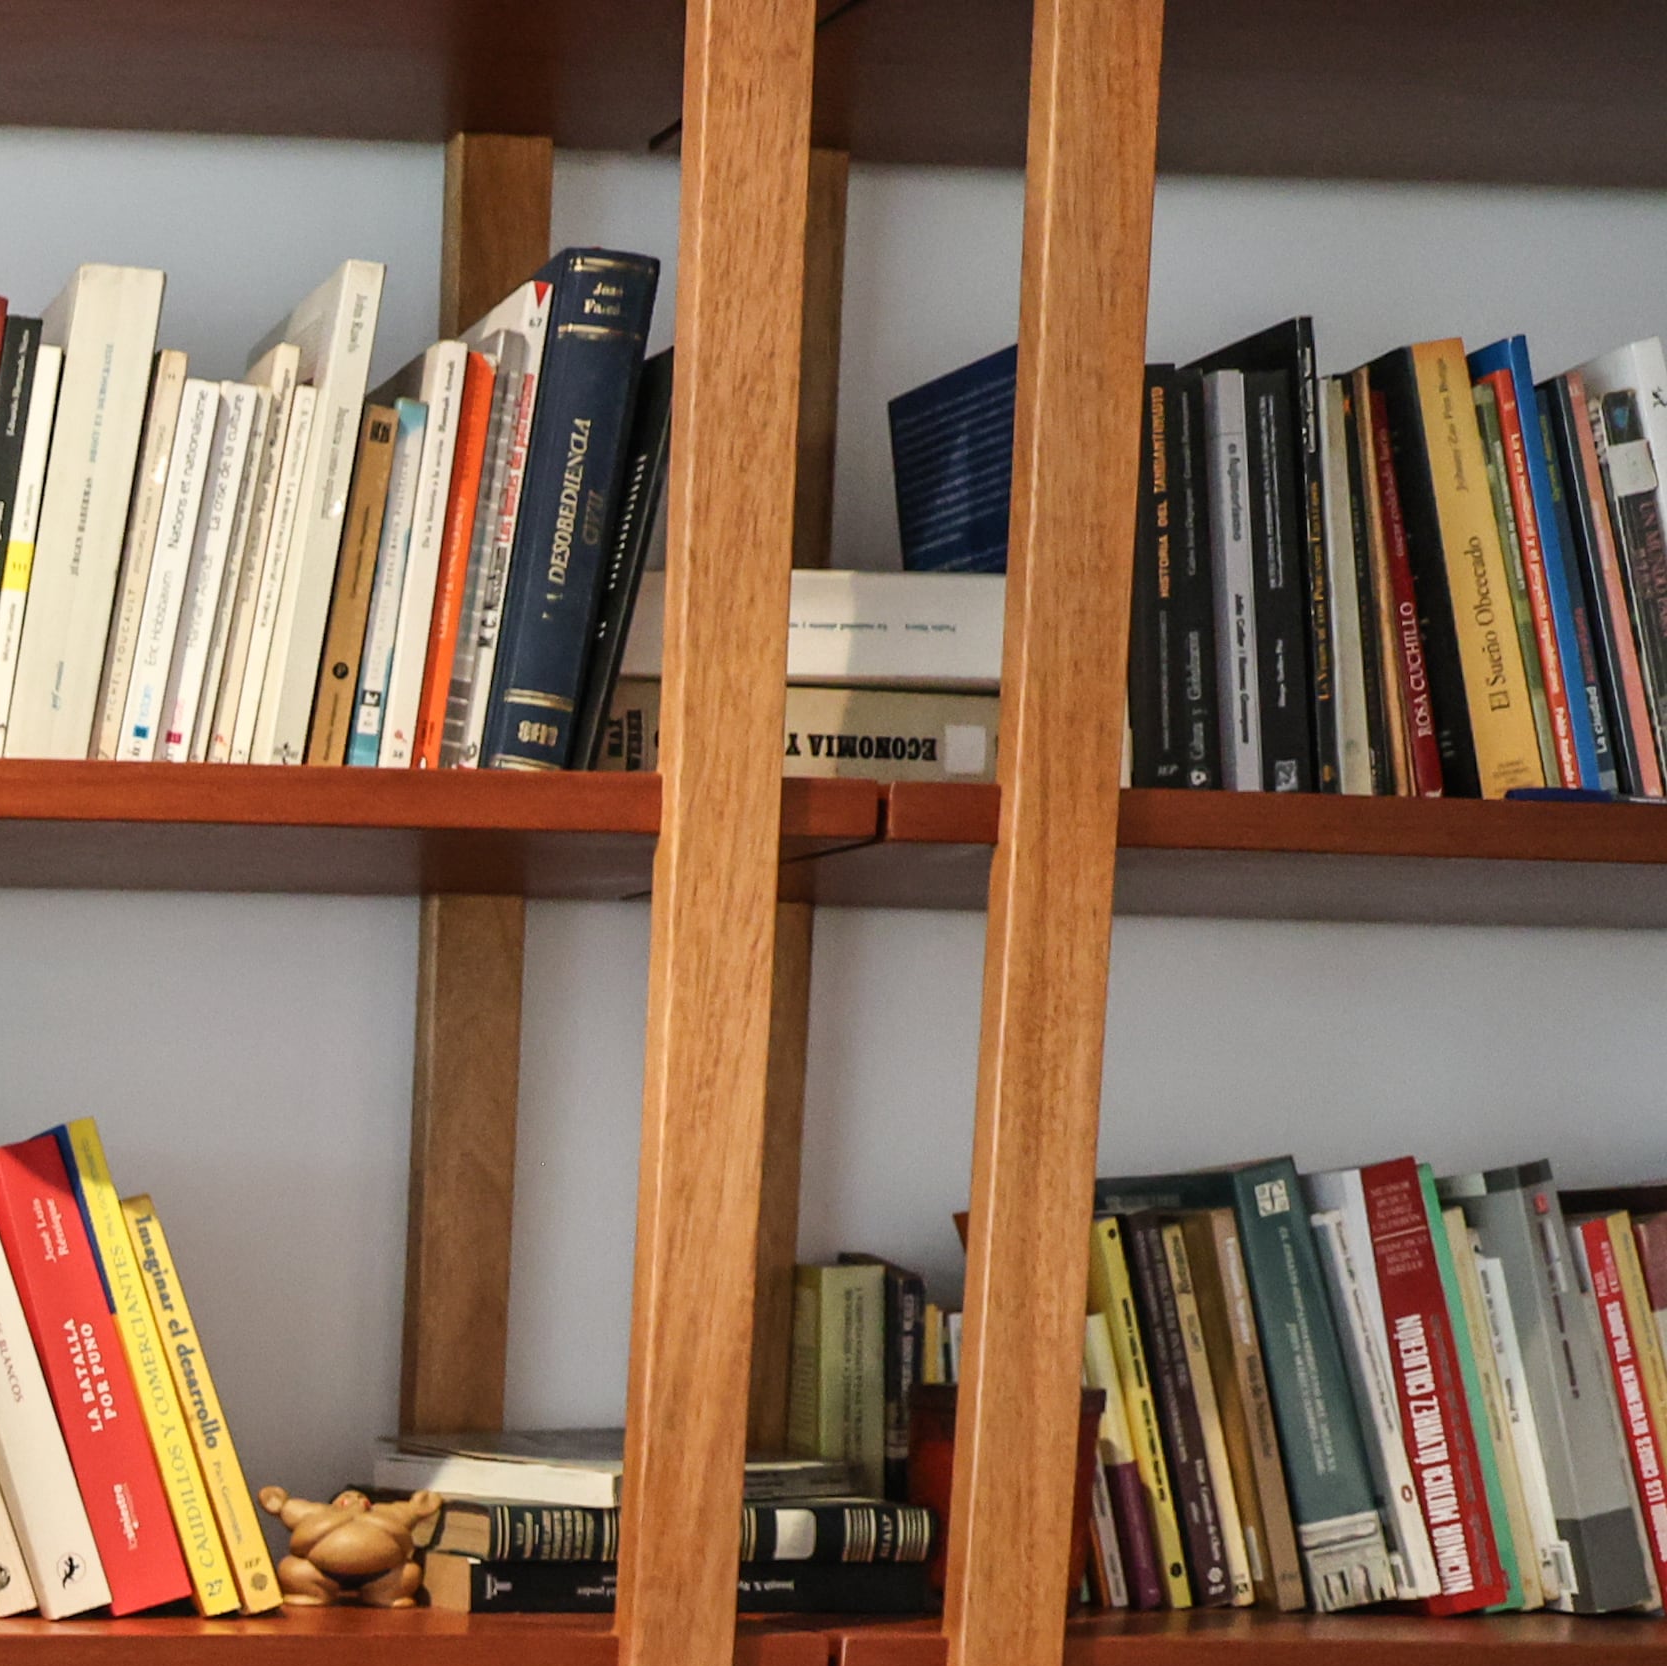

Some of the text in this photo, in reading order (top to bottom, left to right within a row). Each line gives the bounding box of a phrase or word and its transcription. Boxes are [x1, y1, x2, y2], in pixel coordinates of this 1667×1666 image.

[541, 417, 597, 583] DESOBEDIENCIA
[1398, 601, 1432, 736] ROSA CUCHILLO
[1461, 534, 1511, 711] El Sueño Obcecado
[784, 732, 937, 761] ECONOMIA Y
[1585, 685, 1608, 753] La ciudad
[62, 1318, 103, 1432] LA BATALLA
[79, 1322, 117, 1420] POR PUNO
[109, 1243, 216, 1569] CAUDILLOS Y COMERCIANTES
[128, 1213, 224, 1449] Imaginar el desarrollo
[1391, 1313, 1473, 1595] NICANOR MUJICA ÁLVAREZ CALDERÓN
